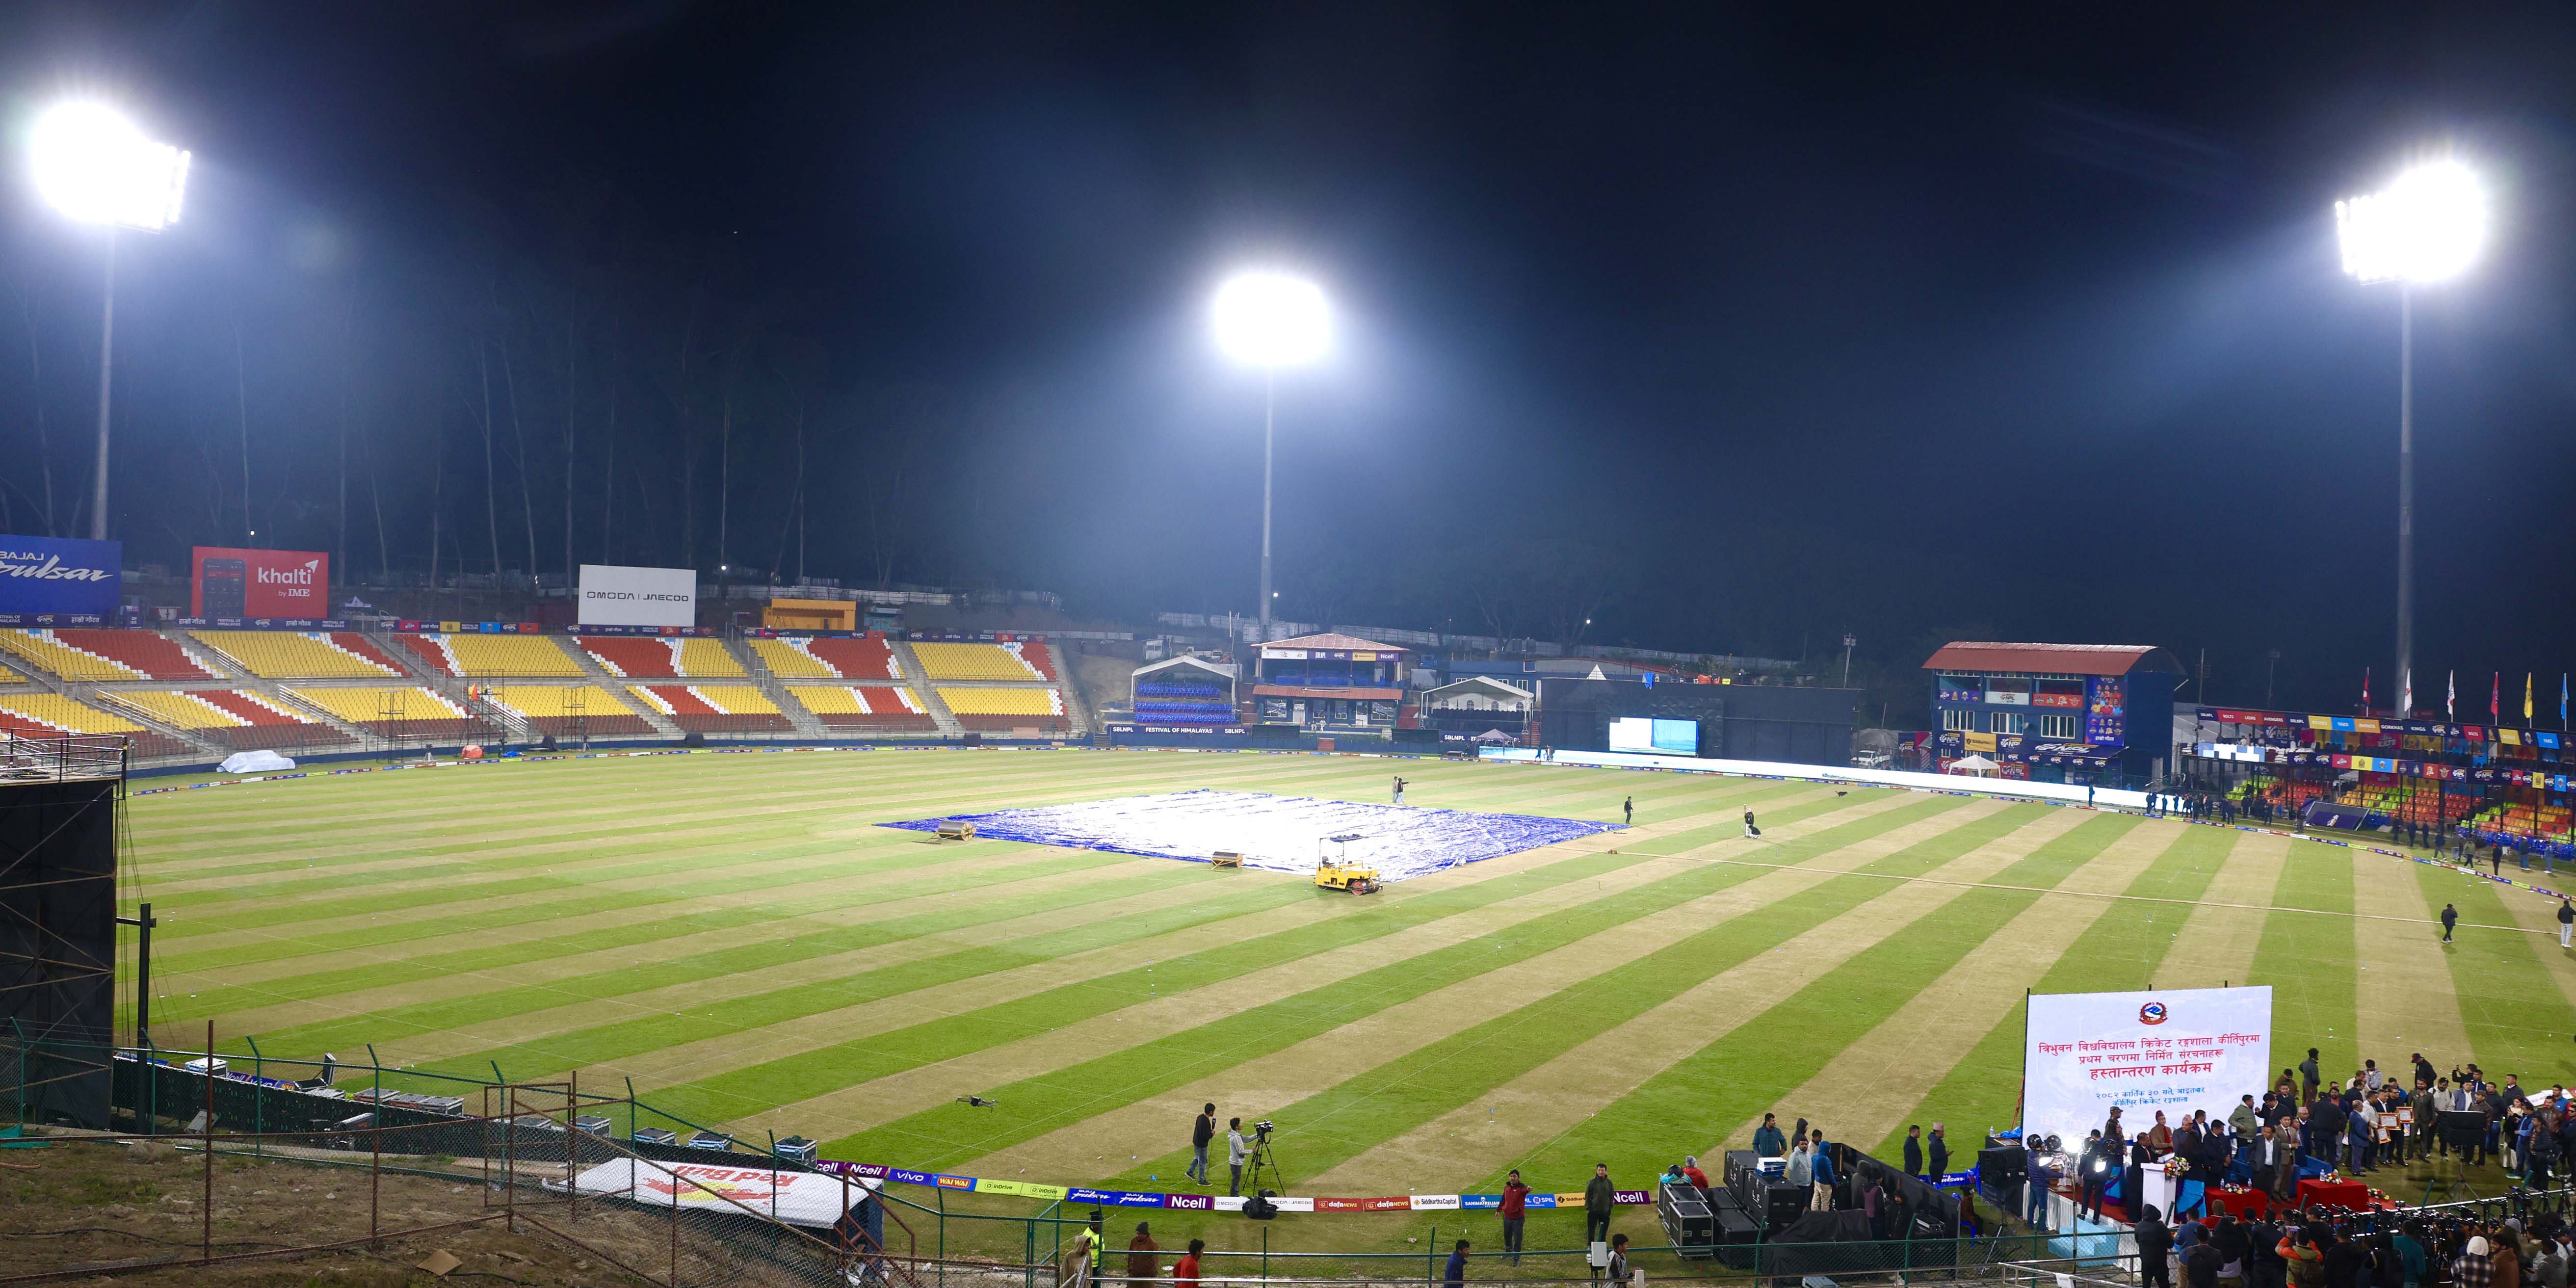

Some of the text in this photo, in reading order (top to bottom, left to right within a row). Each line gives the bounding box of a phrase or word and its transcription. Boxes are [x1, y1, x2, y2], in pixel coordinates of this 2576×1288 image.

[258, 567, 311, 584] khalti
[288, 588, 310, 597] IME
[587, 591, 635, 600] OMODA
[2038, 1042, 2073, 1056] त्रिभुवन
[2078, 1040, 2136, 1051] विश्वविद्यालय
[2141, 1037, 2172, 1049] क्रिकेट
[2217, 1033, 2261, 1047] कीर्तिपुरमा
[2078, 1055, 2103, 1064] प्रथम
[2107, 1053, 2140, 1062] चरणमा
[2145, 1049, 2174, 1061] निर्मित
[2089, 1060, 2213, 1080] हस्तान्तरण कार्यक्रम
[2122, 1089, 2146, 1098] कार्तिक
[816, 1162, 839, 1173] cell
[849, 1164, 883, 1176] Ncell
[675, 1165, 799, 1187] Red Bull
[897, 1172, 924, 1182] vivo
[1119, 1194, 1159, 1204] pulsar
[1171, 1196, 1207, 1209] Ncell
